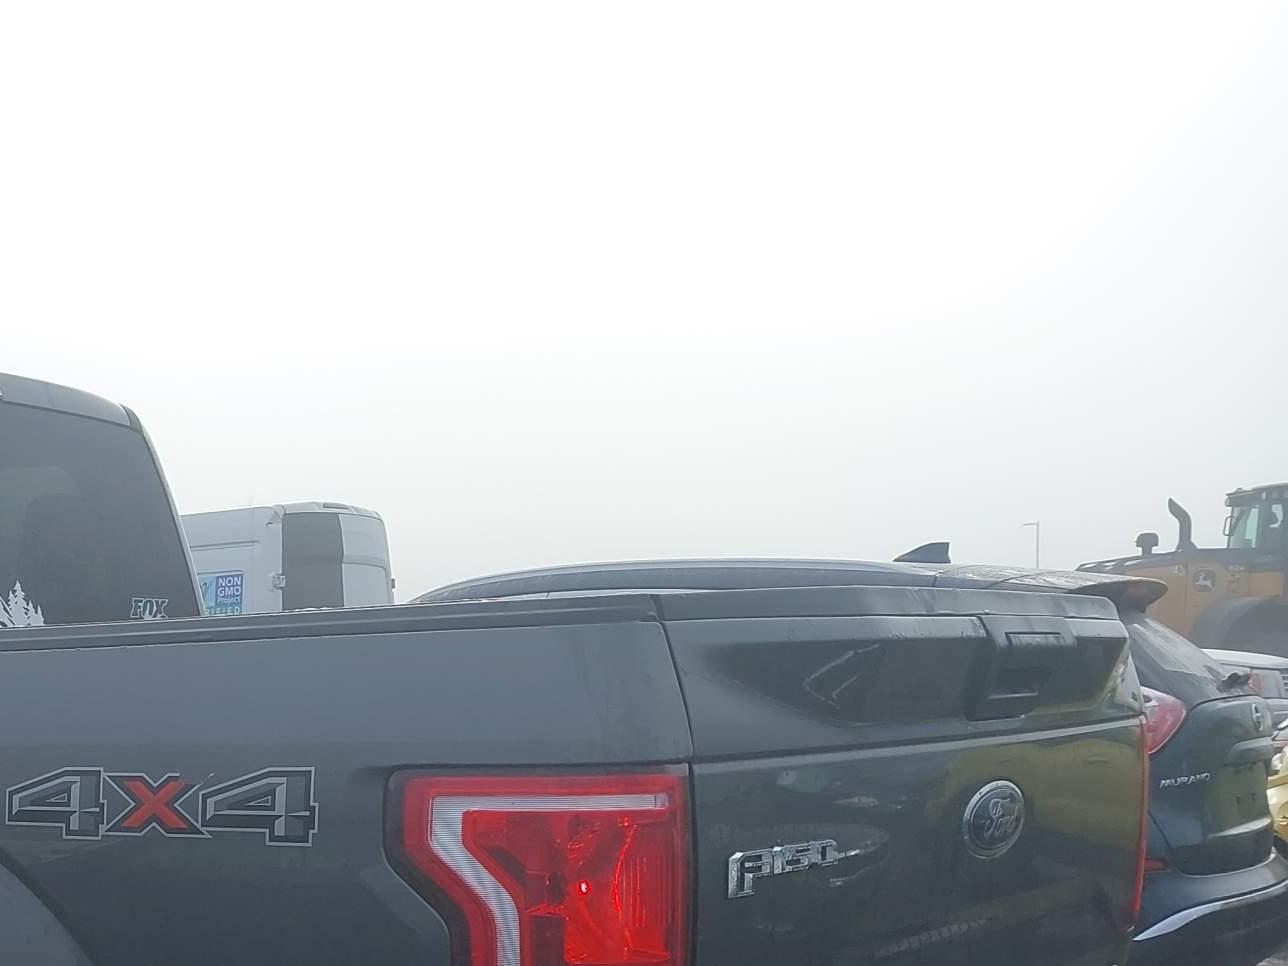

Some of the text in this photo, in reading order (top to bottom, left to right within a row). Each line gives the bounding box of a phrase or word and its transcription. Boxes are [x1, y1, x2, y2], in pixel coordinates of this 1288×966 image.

[218, 576, 241, 587] NON
[217, 585, 241, 597] GMO
[129, 597, 169, 618] FOX
[1159, 772, 1210, 789] MURANO
